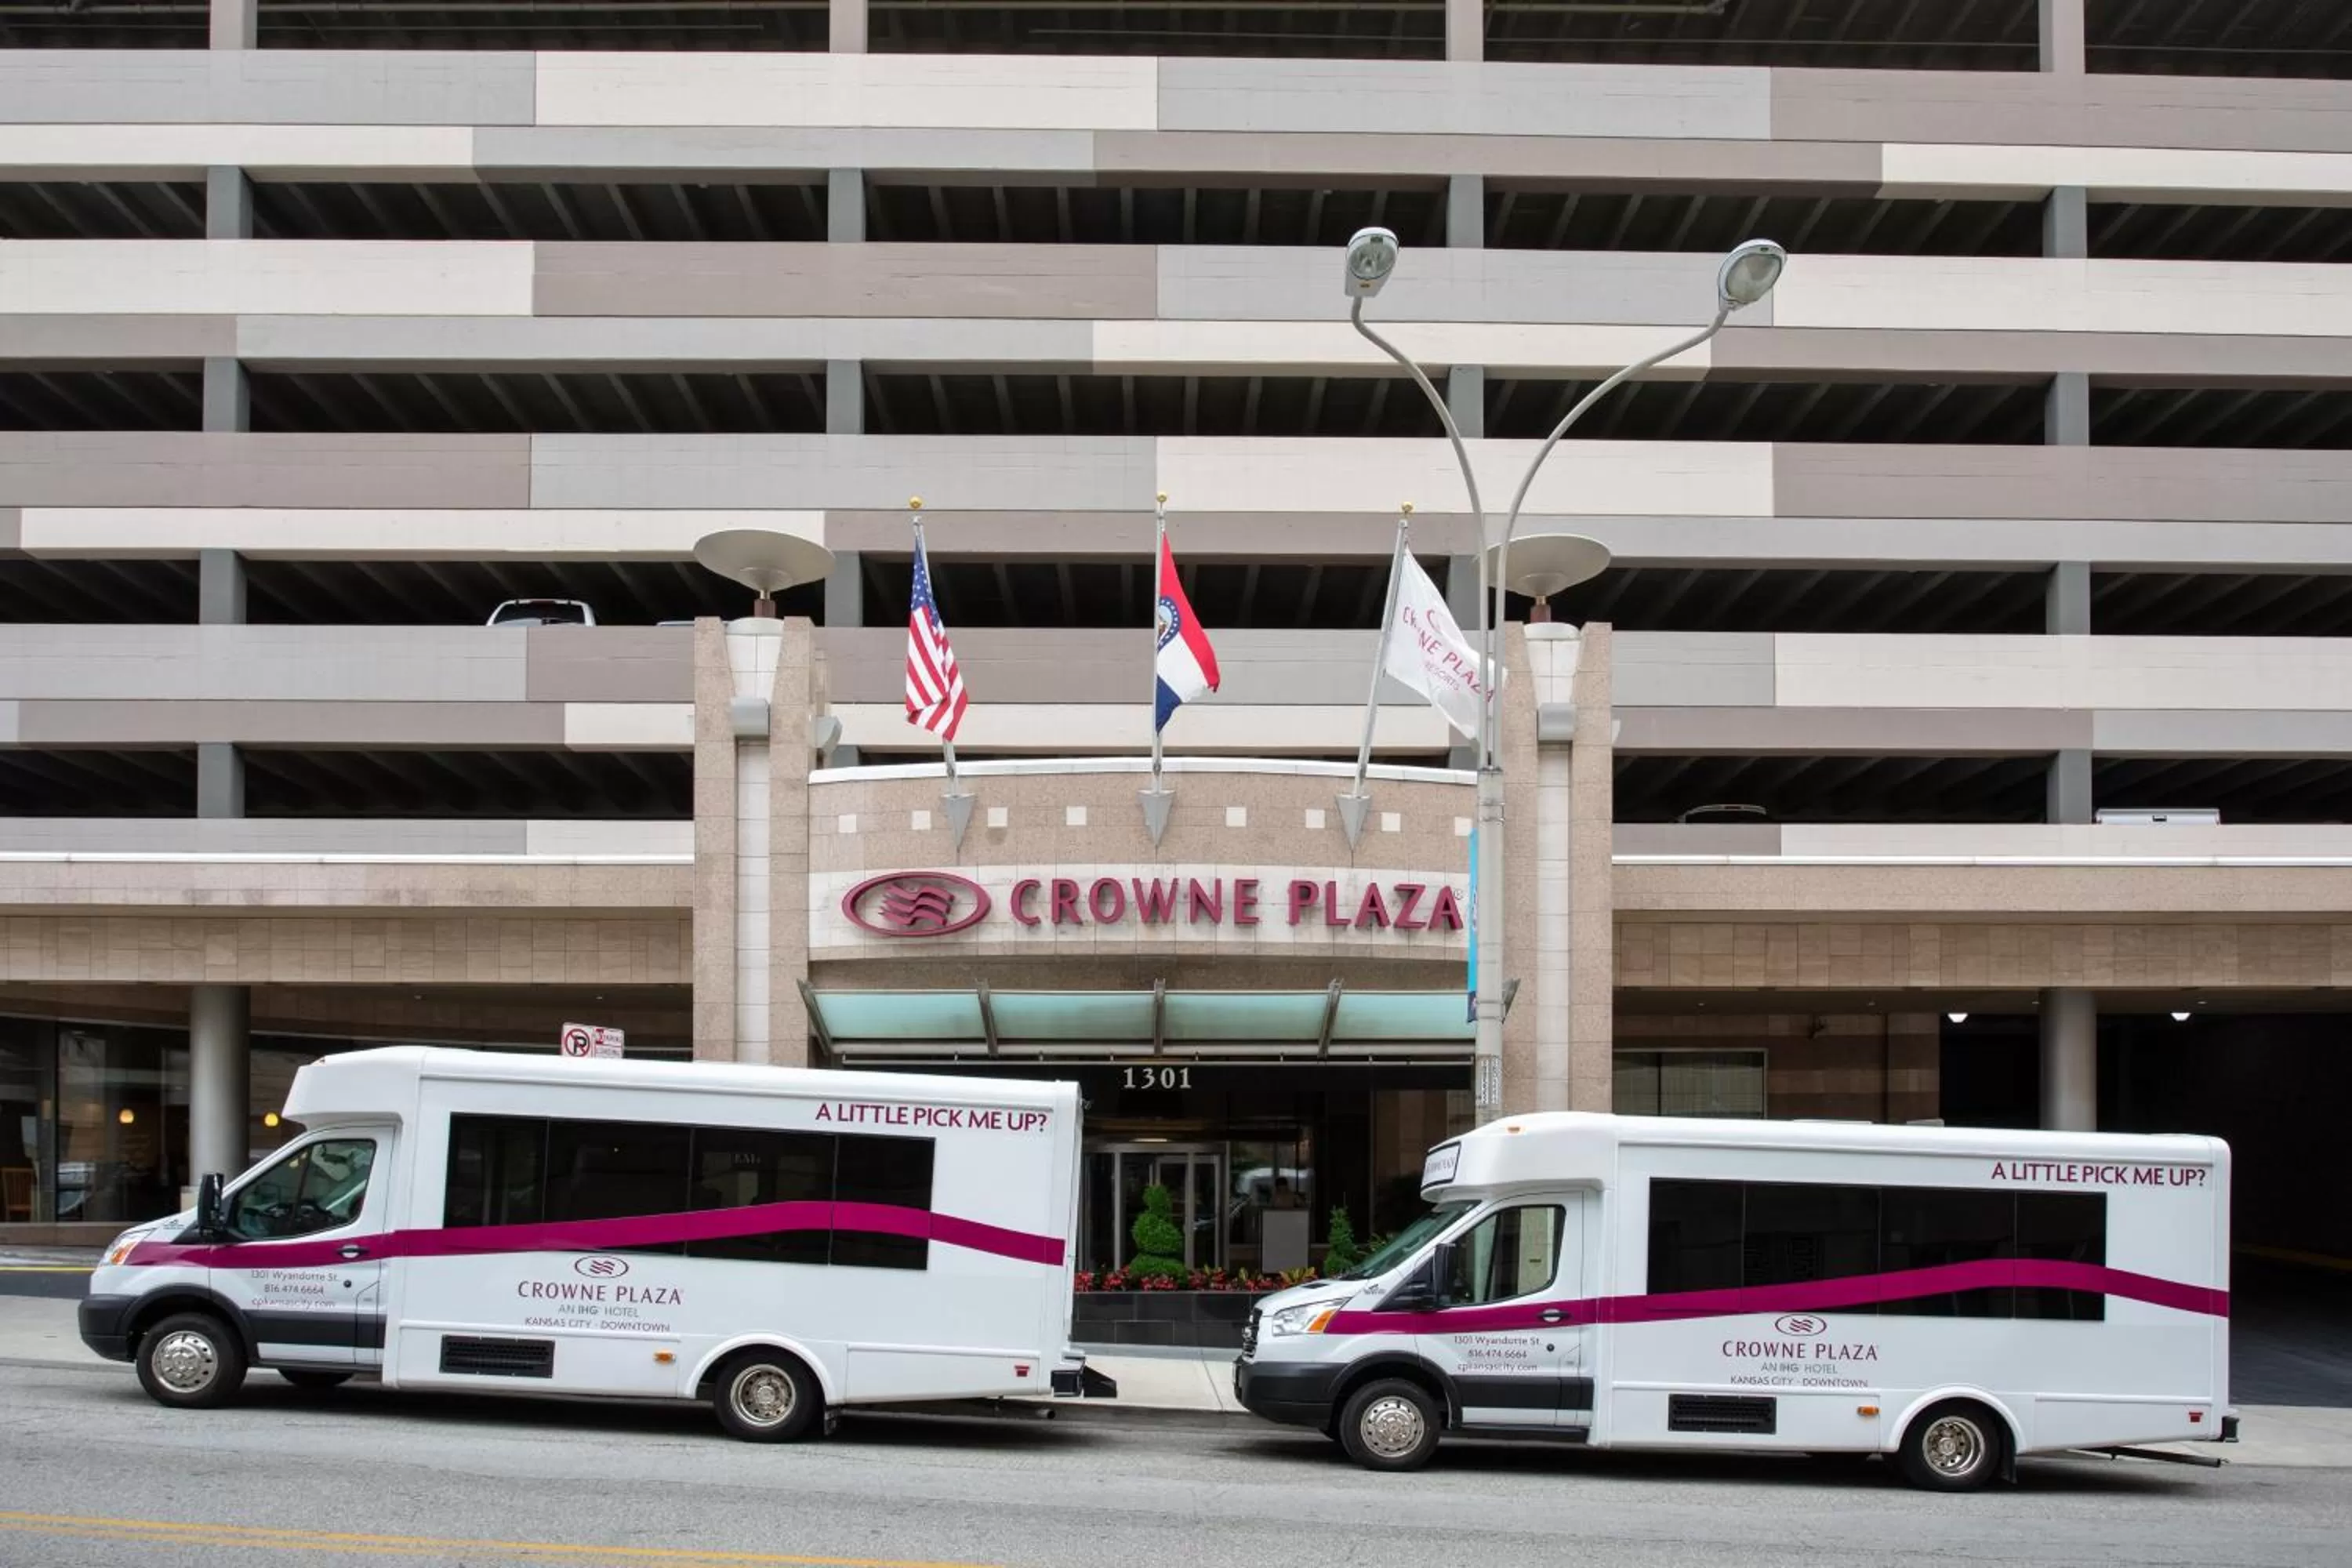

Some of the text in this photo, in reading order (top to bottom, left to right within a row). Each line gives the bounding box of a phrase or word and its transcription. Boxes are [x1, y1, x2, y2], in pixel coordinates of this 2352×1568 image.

[1010, 877, 1260, 927] CROWNE
[1288, 880, 1465, 930] PLAZA
[1123, 1067, 1192, 1089] 1301
[815, 1102, 1047, 1132] A LITTLE PICK ME UP?
[1991, 1162, 2205, 1186] A LITTLE PICK ME UP?
[251, 1270, 269, 1279] 1301
[274, 1271, 325, 1282] Wyandotte
[517, 1280, 681, 1305] CROWNE PLAZA
[558, 1304, 639, 1318] AN IHG HOTEL
[525, 1317, 565, 1327] KANSAS
[568, 1319, 590, 1328] CITY
[601, 1320, 670, 1332] DOWNTOWN
[1454, 1335, 1472, 1344] 1301
[1475, 1336, 1527, 1346] Wyandotte
[1722, 1340, 1878, 1361] CROWNE PLAZA
[1761, 1362, 1838, 1374] AN IHG HOTEL
[1730, 1375, 1769, 1385] KANSAS
[1771, 1376, 1794, 1385] CITY
[1803, 1377, 1868, 1388] DOWNTOWN
